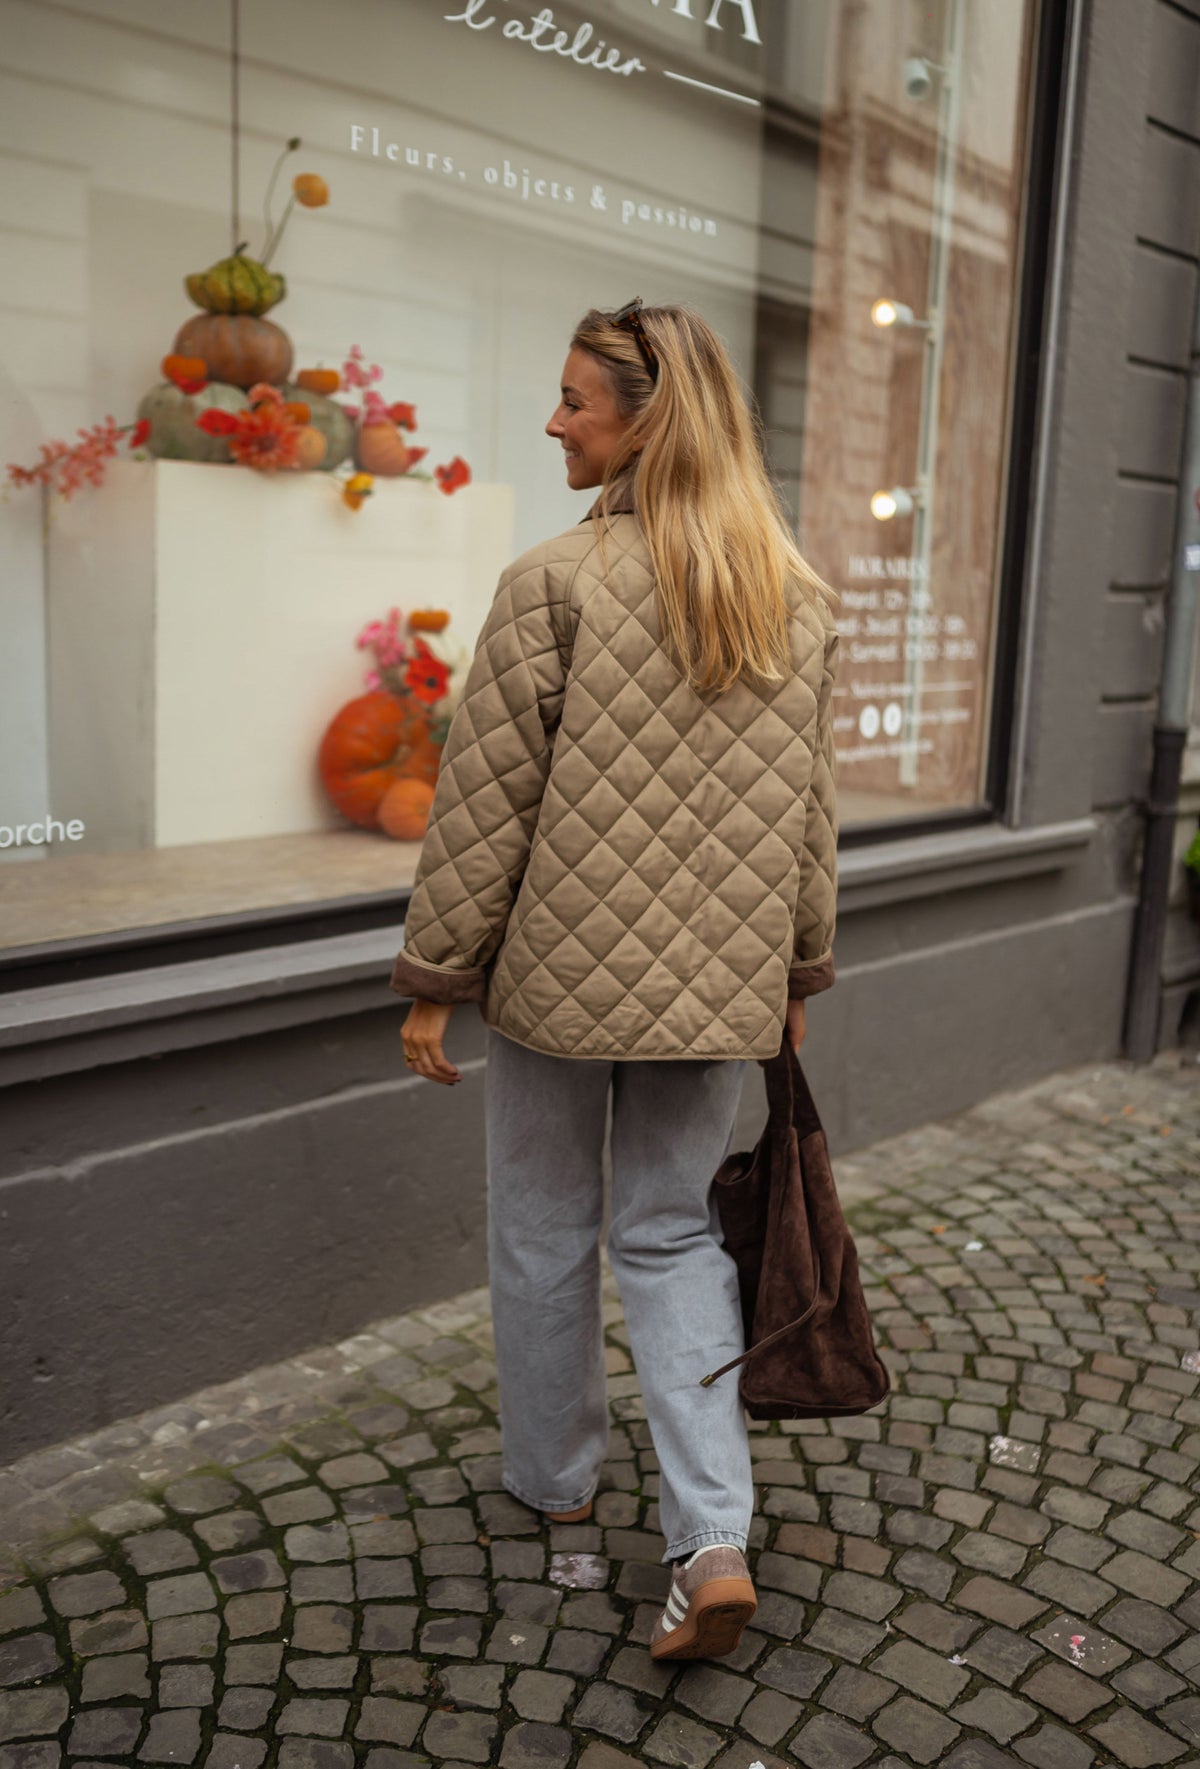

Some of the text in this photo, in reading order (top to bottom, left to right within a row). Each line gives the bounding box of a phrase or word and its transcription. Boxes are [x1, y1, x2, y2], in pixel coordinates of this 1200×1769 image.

[444, 0, 647, 76] latelier
[351, 124, 718, 237] Fleurs, objets & passion
[0, 814, 85, 848] orche
